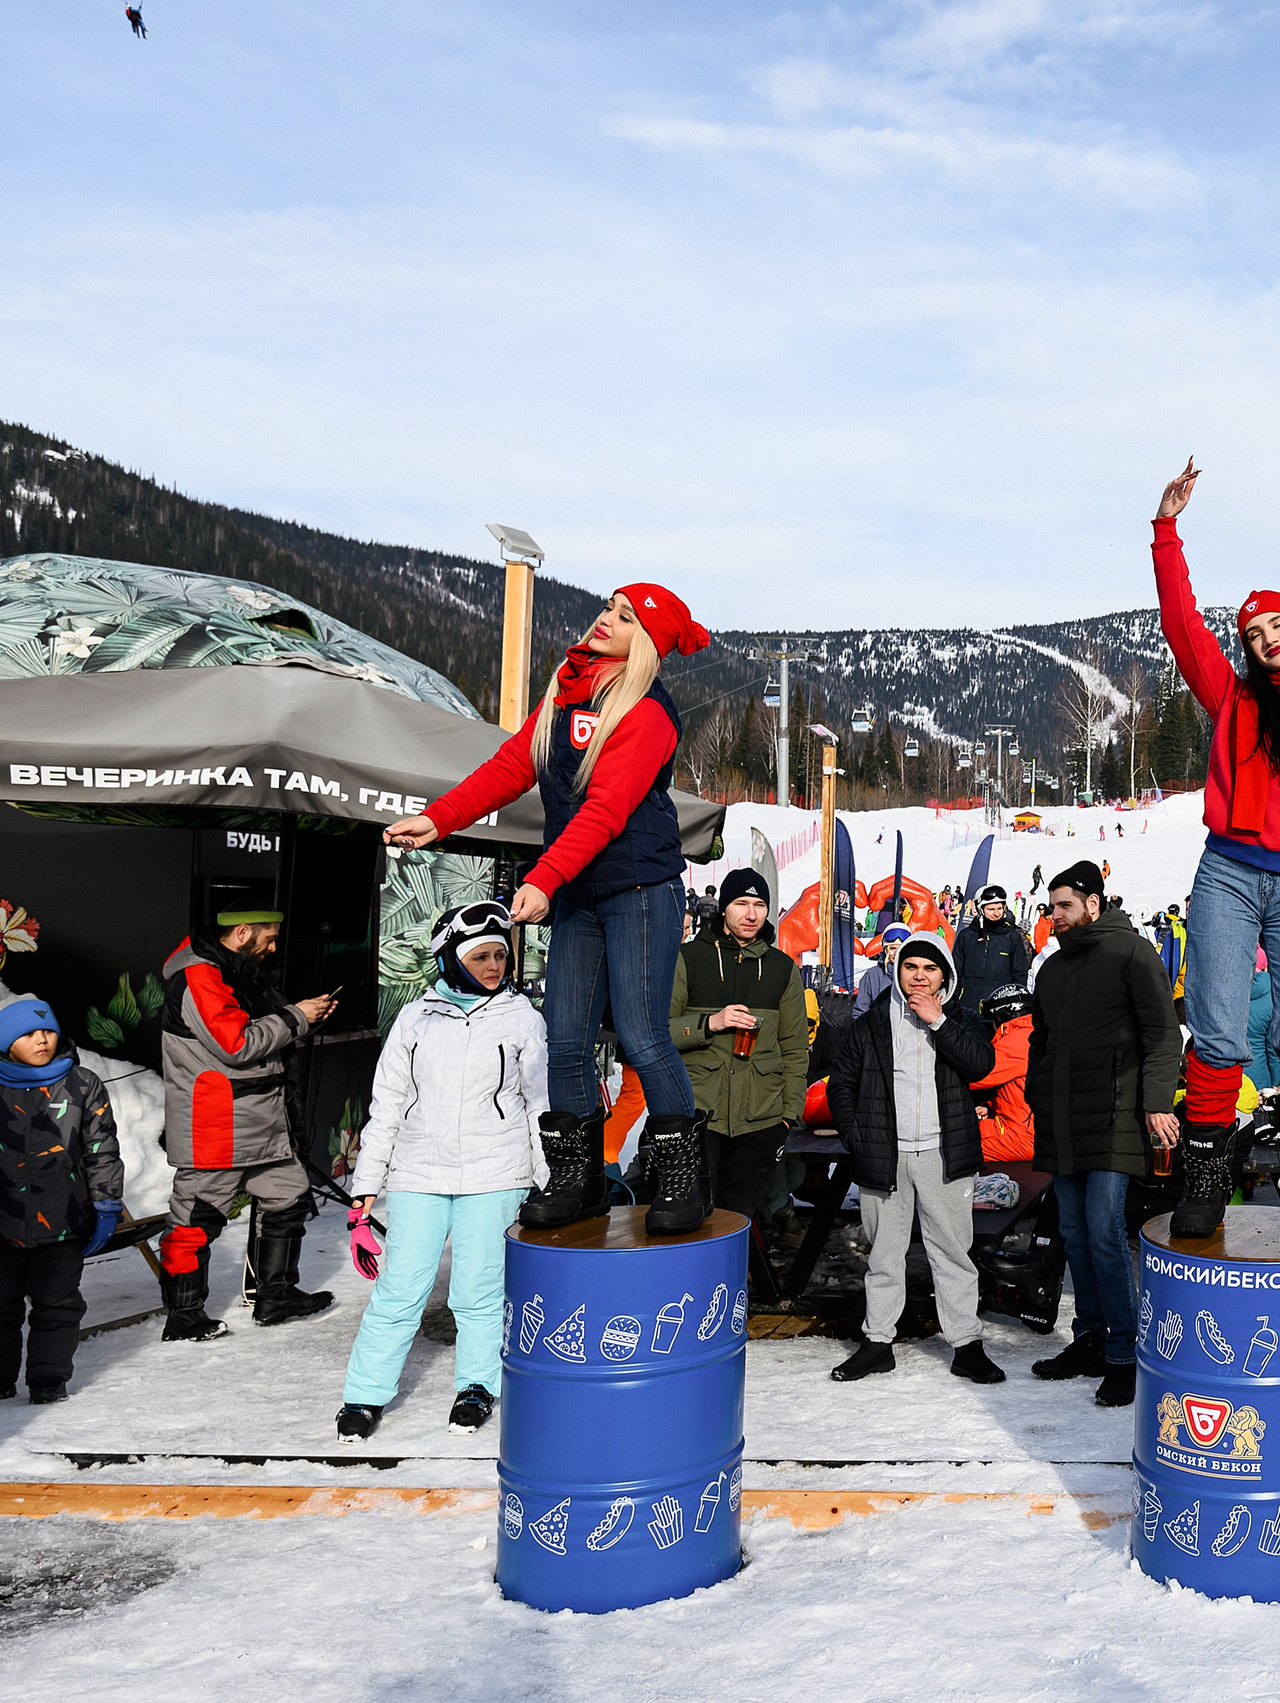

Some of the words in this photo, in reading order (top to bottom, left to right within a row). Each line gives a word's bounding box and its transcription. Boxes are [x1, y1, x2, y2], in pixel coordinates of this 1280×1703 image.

[10, 764, 254, 788] ВЕЧЕРИНКА
[264, 768, 349, 802] ТАМ,
[359, 787, 428, 816] ГДЕ
[227, 831, 272, 853] БУДЬ
[1020, 1313, 1048, 1324] HEAD
[1156, 1445, 1208, 1469] ОМСКИЙ
[1211, 1460, 1262, 1473] БЕКОН
